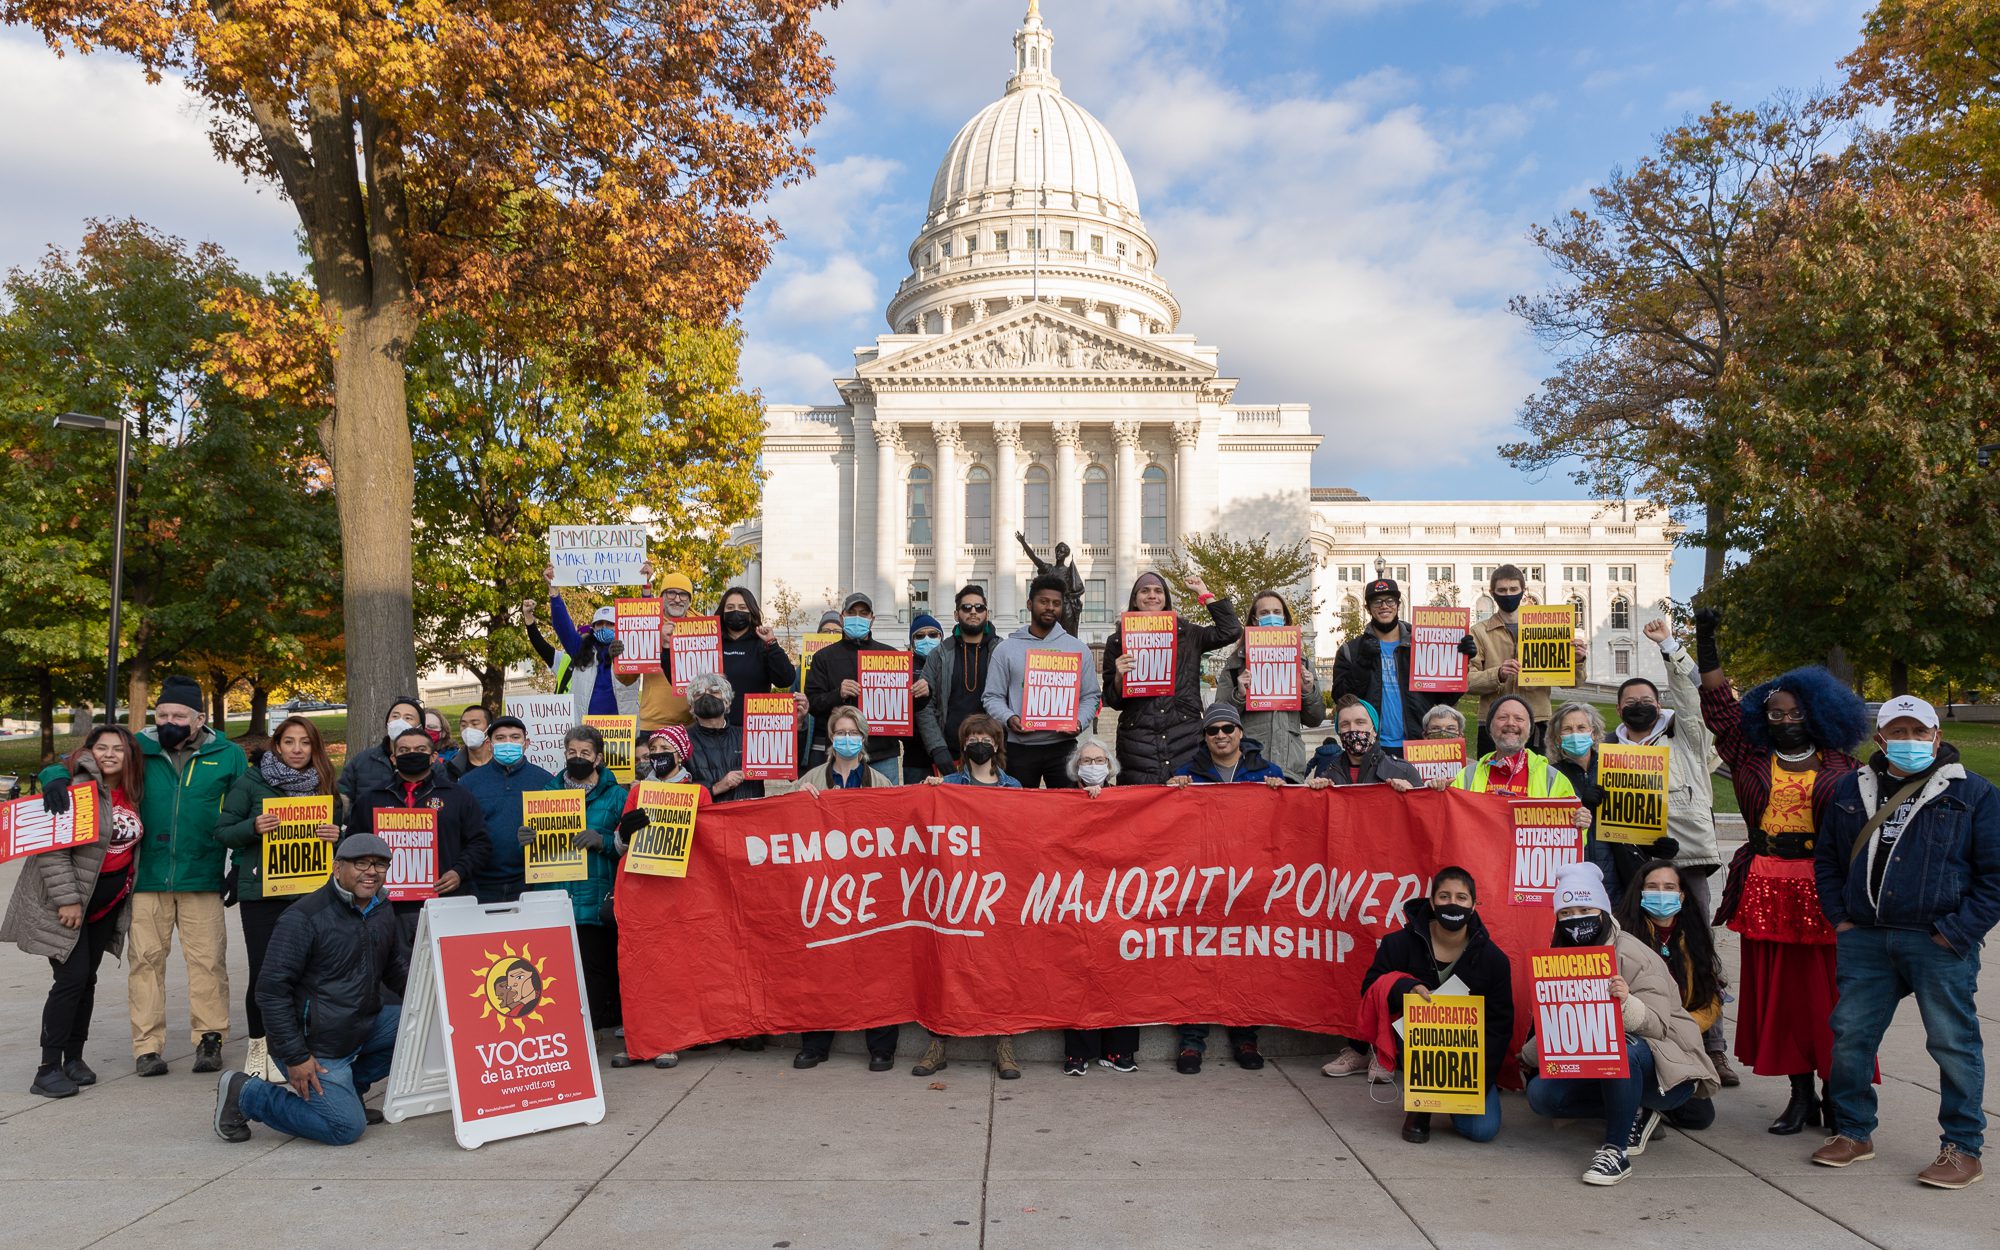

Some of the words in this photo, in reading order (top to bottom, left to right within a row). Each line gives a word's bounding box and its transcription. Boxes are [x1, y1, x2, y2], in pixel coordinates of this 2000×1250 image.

[553, 529, 644, 548] IMMIGRANTS
[556, 552, 587, 566] MAKE
[594, 551, 643, 564] AMERICA
[618, 601, 661, 616] DEMOCRATS
[1522, 610, 1571, 625] DEMÓCRATAS
[618, 616, 661, 631] CITIZENSHIP
[673, 620, 718, 636] DEMOCRATS
[1125, 615, 1174, 632] DEMOCRATS
[1415, 611, 1466, 627] DEMOCRATS
[1125, 632, 1173, 649] CITIZENSHIP
[1249, 631, 1297, 646] DEMOCRATS
[1415, 627, 1466, 643] CITIZENSHIP
[1521, 625, 1571, 642] ¡CIUDADANÍA
[618, 630, 661, 661] NOW!
[673, 636, 718, 652] CITIZENSHIP
[861, 655, 909, 671] DEMOCRATS
[1029, 654, 1079, 671] DEMOCRATS
[1249, 647, 1297, 663] CITIZENSHIP
[1413, 643, 1464, 677] NOW!
[1522, 642, 1571, 669] AHORA!
[674, 650, 719, 683] NOW!
[1126, 648, 1173, 682] NOW!
[861, 672, 909, 688] CITIZENSHIP
[1028, 671, 1077, 687] CITIZENSHIP
[1250, 662, 1297, 696] NOW!
[507, 703, 525, 719] NO
[530, 702, 571, 719] HUMAN
[747, 698, 794, 714] DEMOCRATS
[862, 687, 909, 721] NOW!
[1026, 686, 1076, 717] NOW!
[746, 715, 793, 731] CITIZENSHIP
[600, 728, 632, 739] DADANÍA
[529, 739, 565, 752] STOLE
[603, 740, 631, 767] ORA!
[746, 731, 793, 764] NOW!
[1407, 743, 1462, 761] DEMOCRATS
[1602, 752, 1664, 771] DEMÓCRATAS
[1412, 762, 1462, 781] TIZENSHIP
[1602, 771, 1664, 791] ¡CIUDADANÍA
[527, 797, 581, 814] DEMÓCRATAS
[642, 788, 694, 808] DEMÓCRATAS
[74, 785, 94, 842] DEMOCRATS
[644, 807, 691, 826] IUDADANÍA
[1514, 807, 1576, 826] DEMOCRATS
[1601, 790, 1662, 826] AHORA!
[15, 798, 54, 855] NOW!
[377, 812, 434, 830] DEMOCRATS
[1764, 822, 1809, 834] VOCES
[632, 823, 690, 857] AHORA!
[745, 824, 981, 867] DEMOCRATS!
[1515, 827, 1579, 847] CITIZENSHIP
[268, 840, 328, 876] AHORA!
[800, 871, 883, 929] USE
[899, 865, 1007, 927] YOUR
[1020, 865, 1254, 927] MAJORITY
[1119, 924, 1355, 963] CITIZENSHIP
[1532, 952, 1612, 979] DEMOCRATS
[1535, 978, 1612, 1004] CITIZENSHIP
[1409, 1002, 1478, 1025] DEMÓCRATAS
[1409, 1026, 1479, 1048] ¡CIUDADANÍA
[1539, 1002, 1619, 1054] NOW!
[475, 1032, 568, 1069] VOCES
[480, 1070, 499, 1085] de
[499, 1067, 514, 1081] la
[515, 1060, 571, 1079] Frontera
[1409, 1049, 1478, 1089] AHORA!
[501, 1079, 556, 1095] www.vdlf.org
